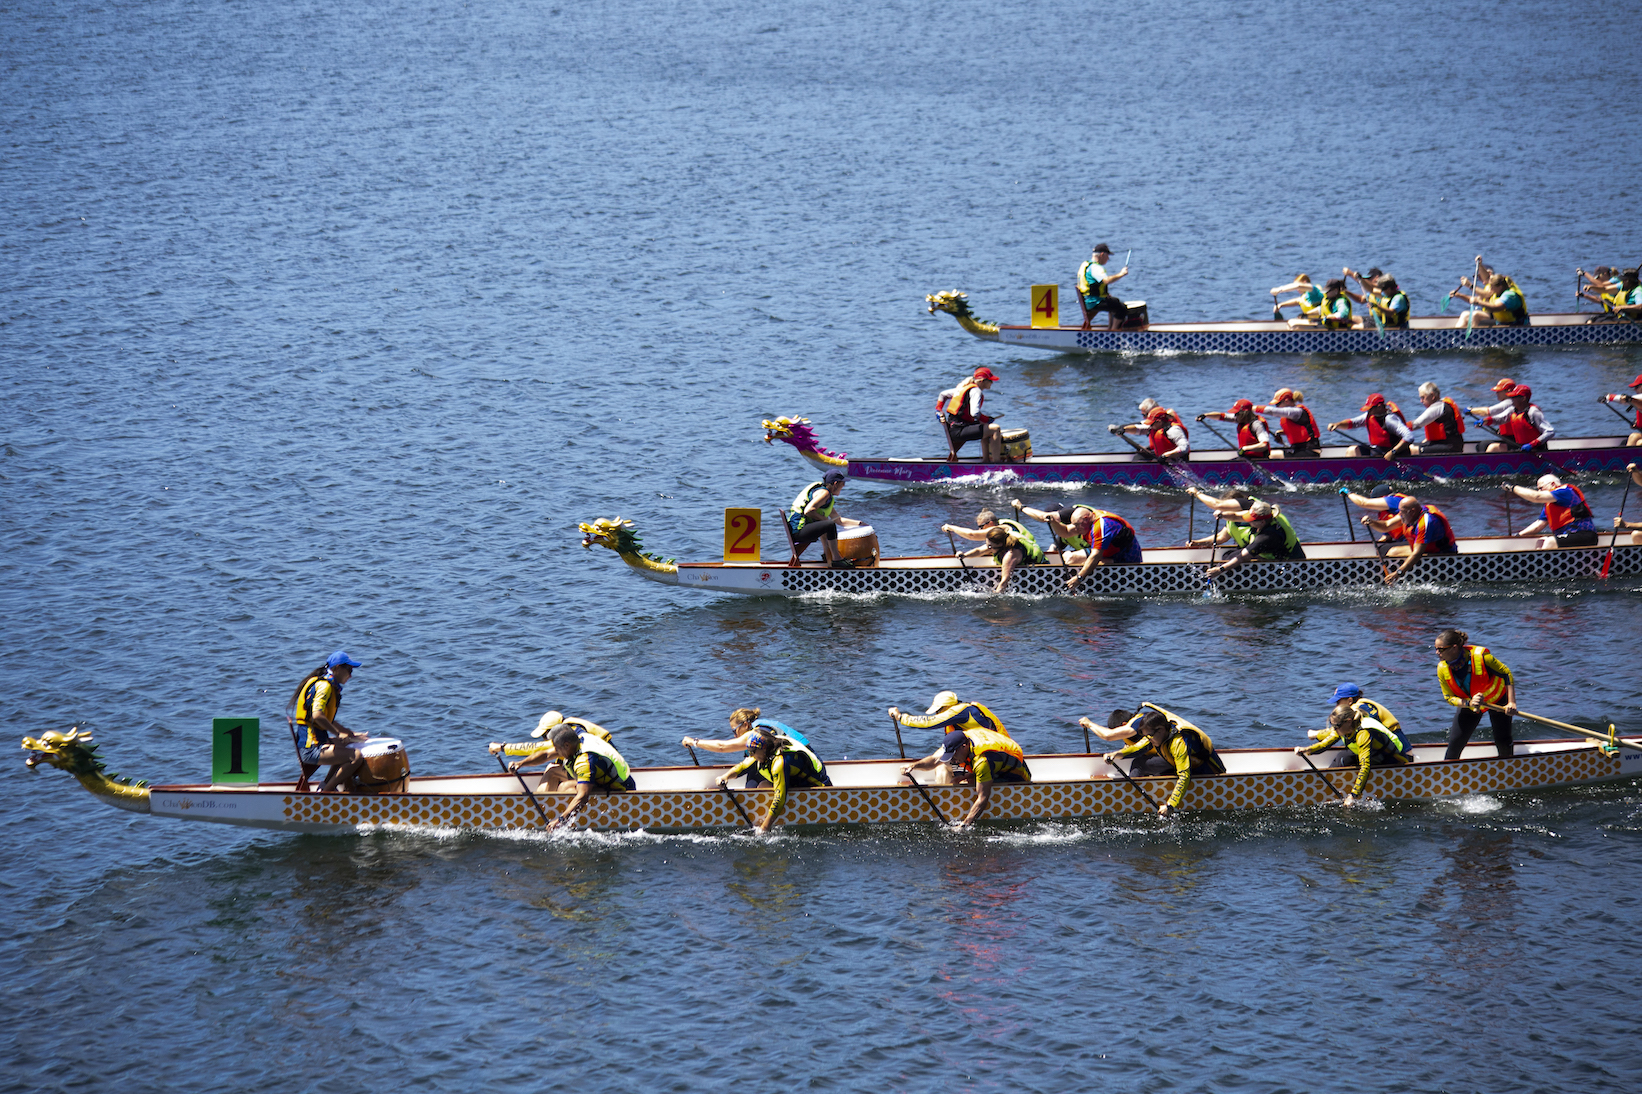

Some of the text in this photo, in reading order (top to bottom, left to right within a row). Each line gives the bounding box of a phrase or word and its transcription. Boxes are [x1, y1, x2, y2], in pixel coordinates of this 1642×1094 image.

[1036, 289, 1054, 318] 4
[730, 514, 757, 554] 2
[223, 725, 249, 774] 1
[162, 797, 237, 810] ChaionDB.com
